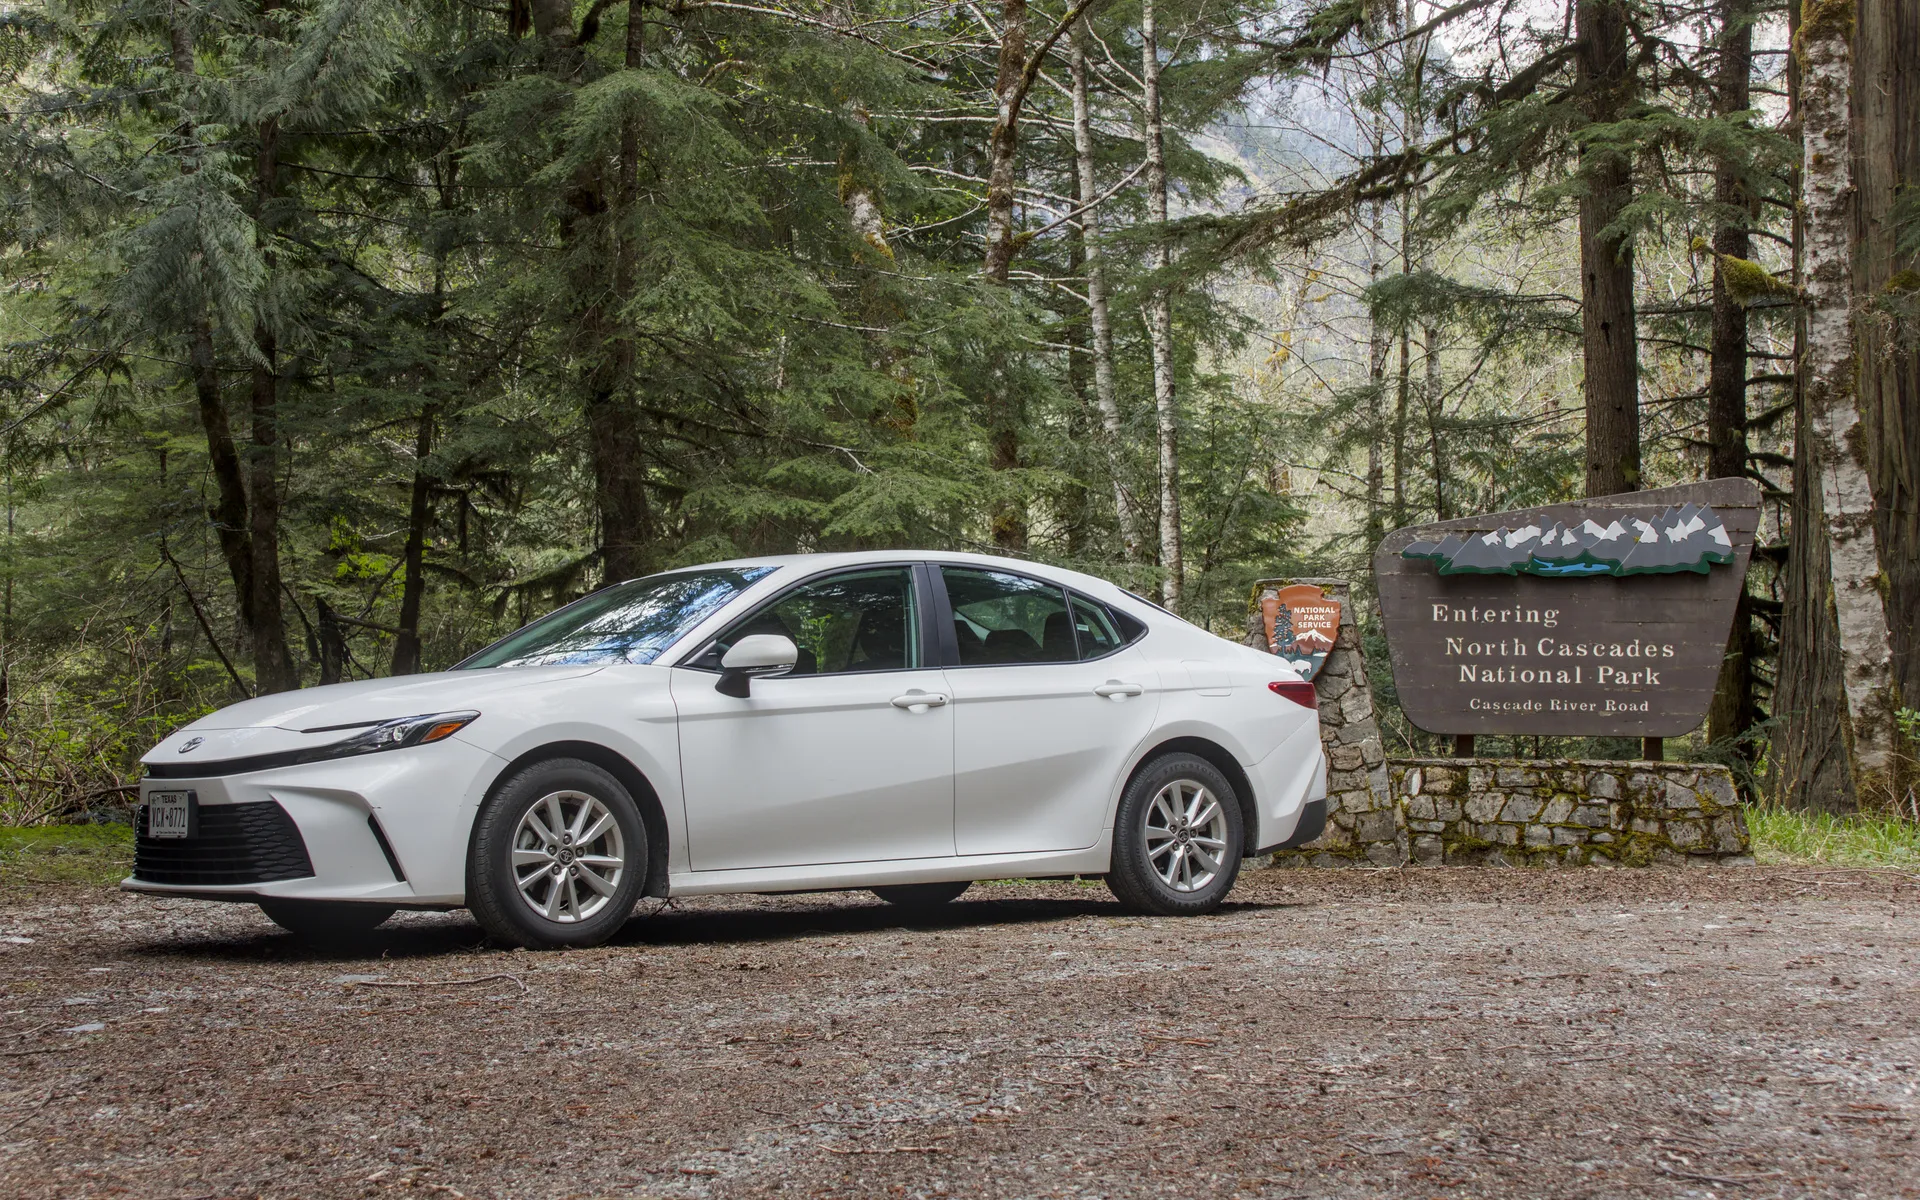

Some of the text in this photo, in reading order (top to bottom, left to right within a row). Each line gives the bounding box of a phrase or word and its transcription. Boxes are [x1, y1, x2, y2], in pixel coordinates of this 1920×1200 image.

[1432, 604, 1560, 628] Entering
[1297, 621, 1332, 629] SERVICE
[1445, 637, 1675, 658] North Cascades
[1458, 664, 1661, 685] National Park
[1469, 698, 1650, 712] Cascade River Road
[161, 794, 177, 804] TEXAS
